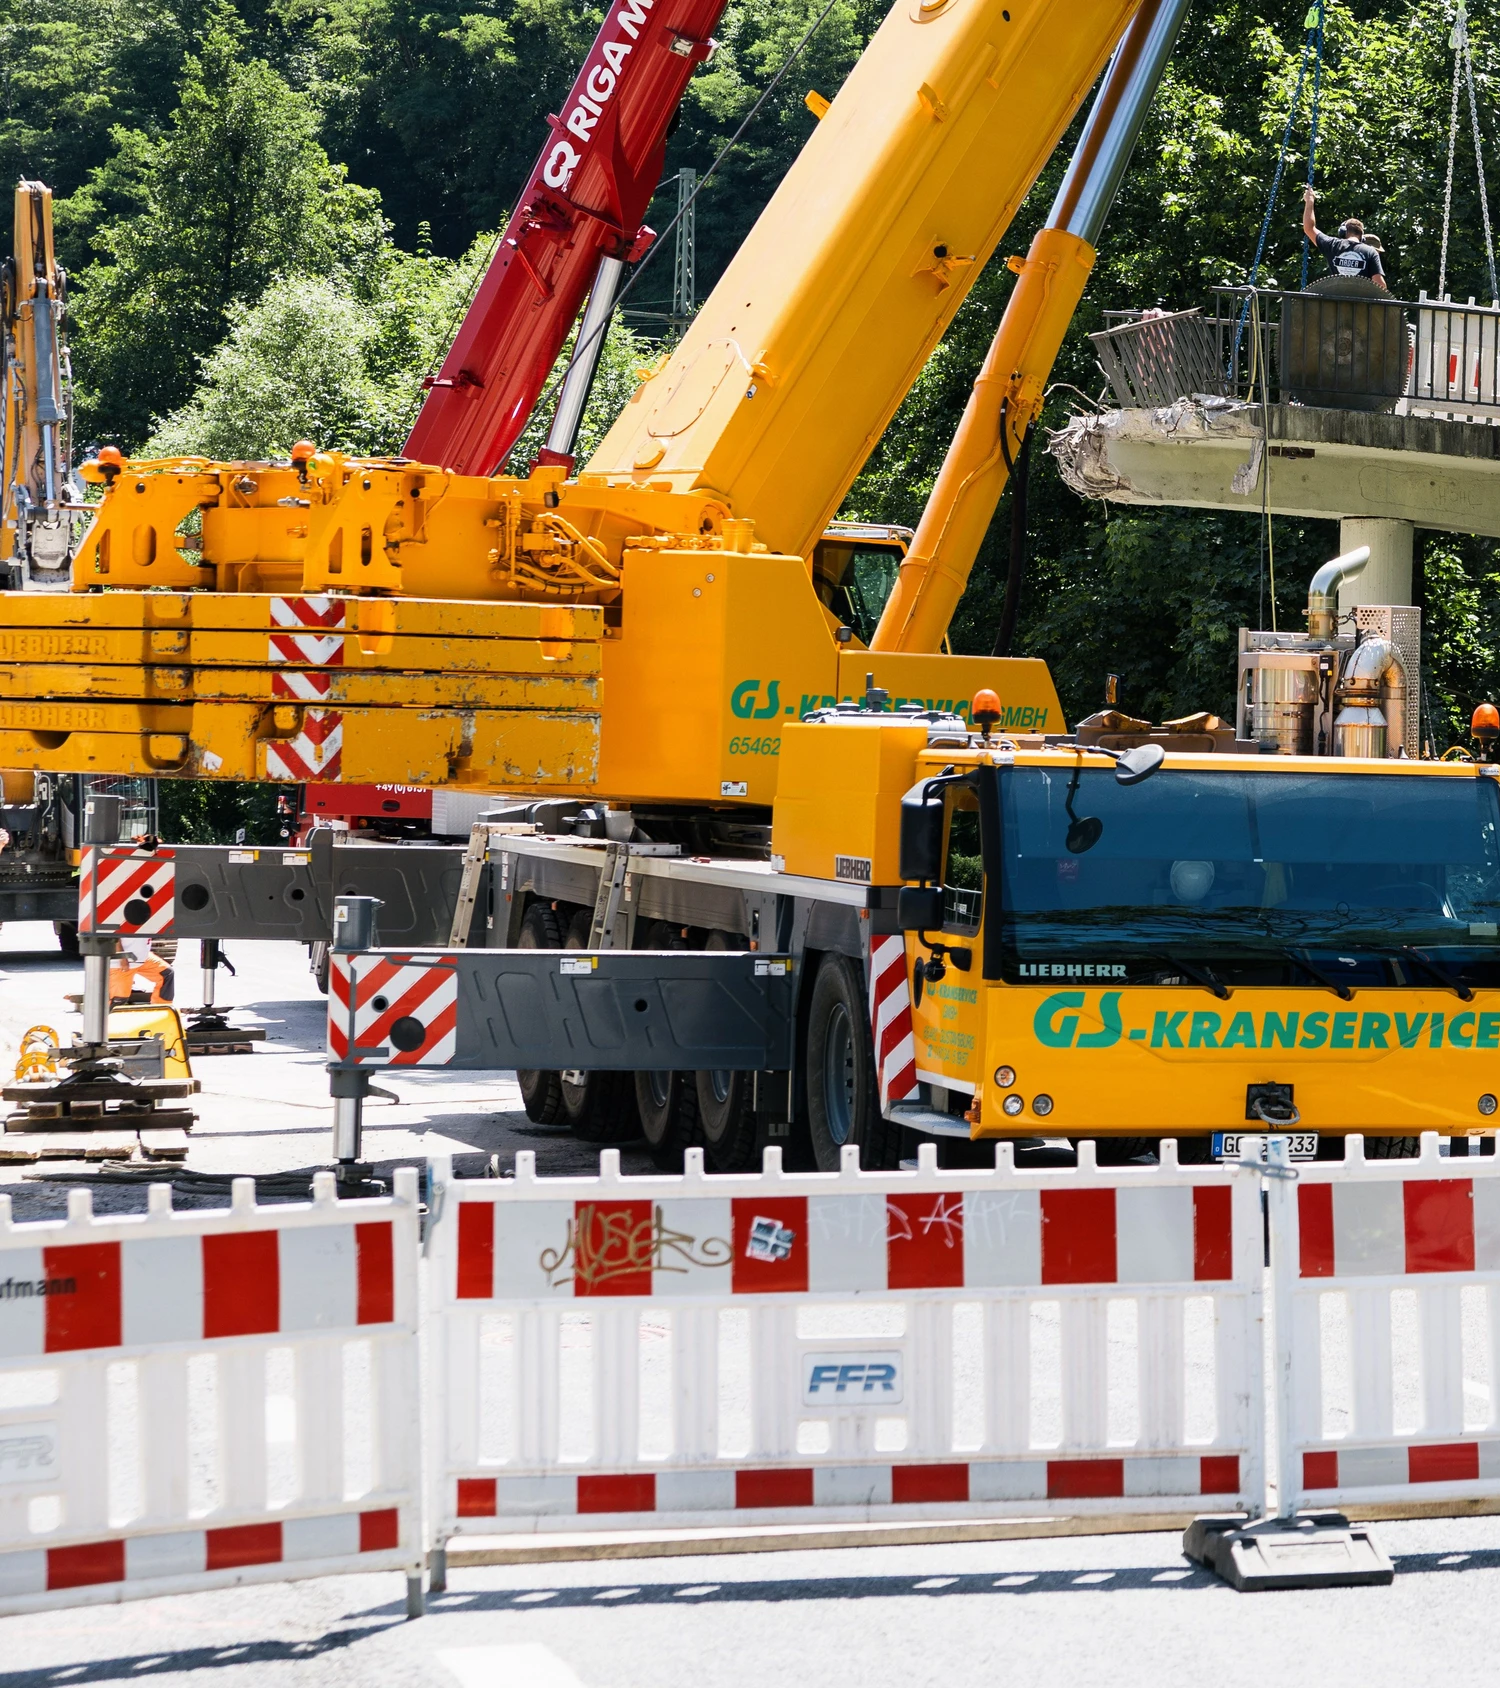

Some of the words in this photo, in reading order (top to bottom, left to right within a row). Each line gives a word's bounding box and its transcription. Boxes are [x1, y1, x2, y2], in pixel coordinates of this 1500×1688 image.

[567, 41, 633, 143] RIGA
[728, 736, 781, 756] 65462
[835, 856, 872, 882] LIEBHERR
[1019, 963, 1127, 977] LIEBHERR
[808, 1364, 897, 1393] FFR
